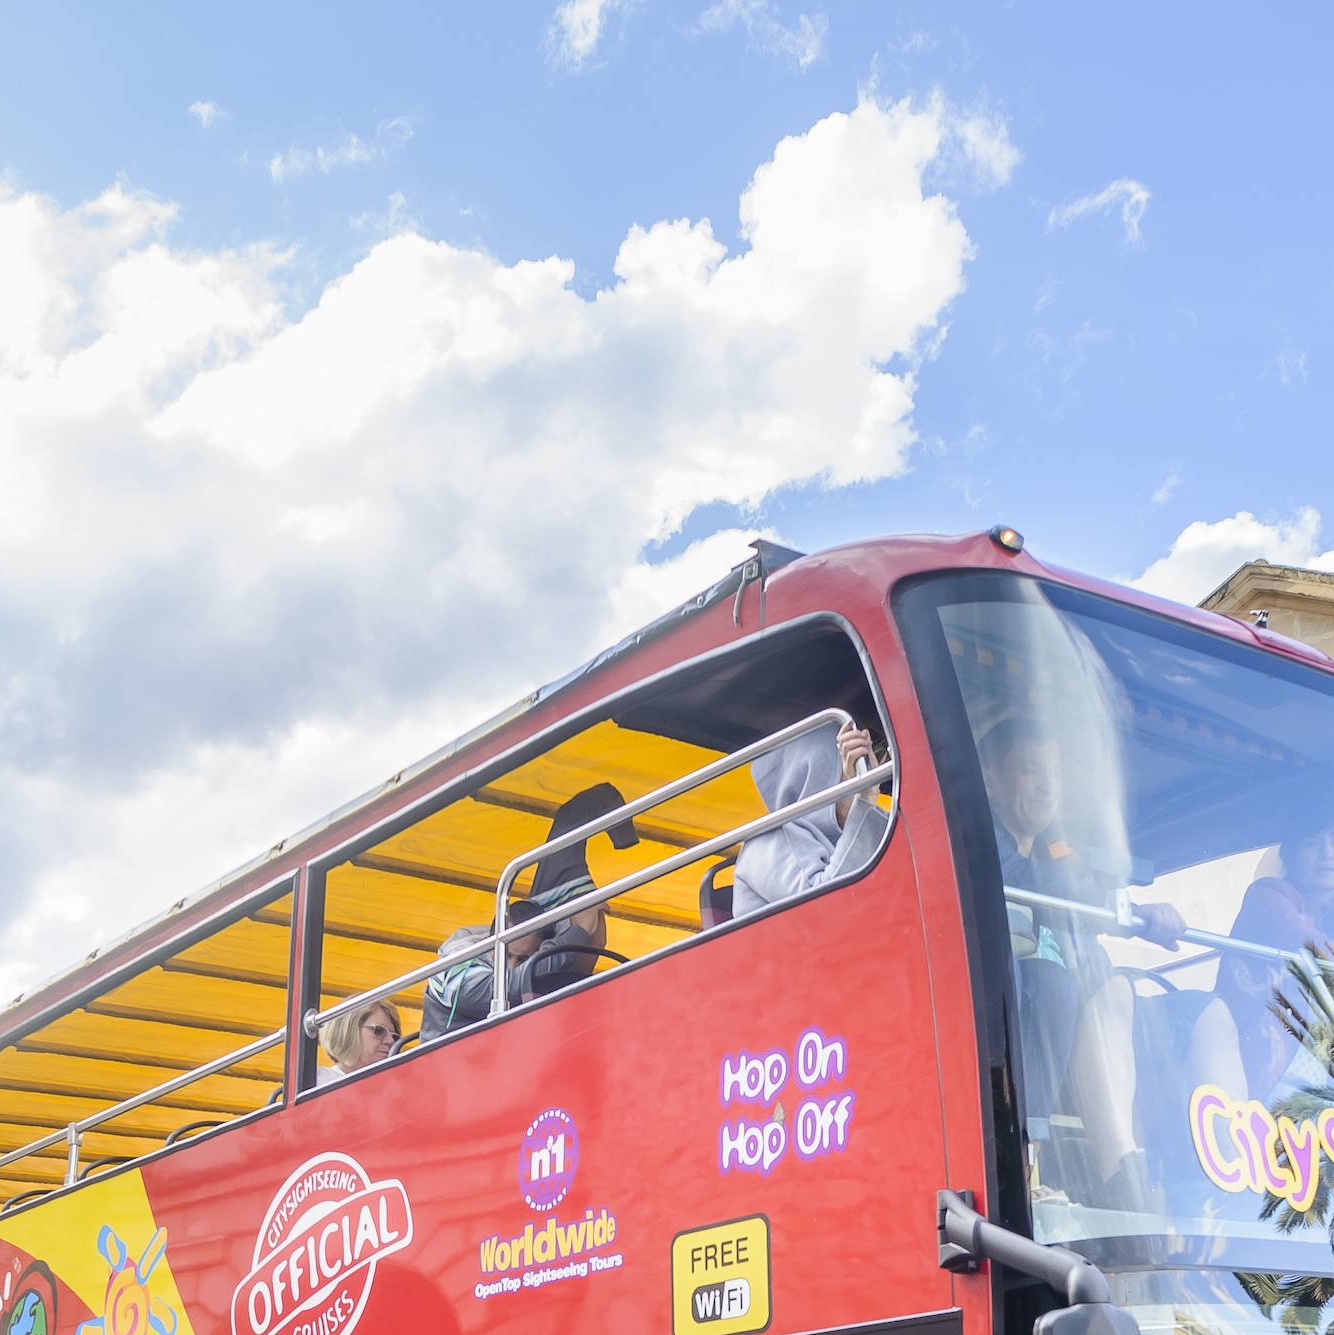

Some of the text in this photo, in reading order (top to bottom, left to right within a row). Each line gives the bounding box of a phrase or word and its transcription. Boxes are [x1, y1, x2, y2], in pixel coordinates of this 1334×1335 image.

[723, 1031, 844, 1101] Hop On
[721, 1095, 852, 1170] Hop Off
[267, 1169, 357, 1248] CITYSIGHTSEEING
[480, 1208, 616, 1273] Worldwide
[248, 1195, 399, 1335] OFFICIAL
[523, 1262, 588, 1288] Sightseeing
[590, 1254, 623, 1273] Tours
[691, 1237, 749, 1274] FREE
